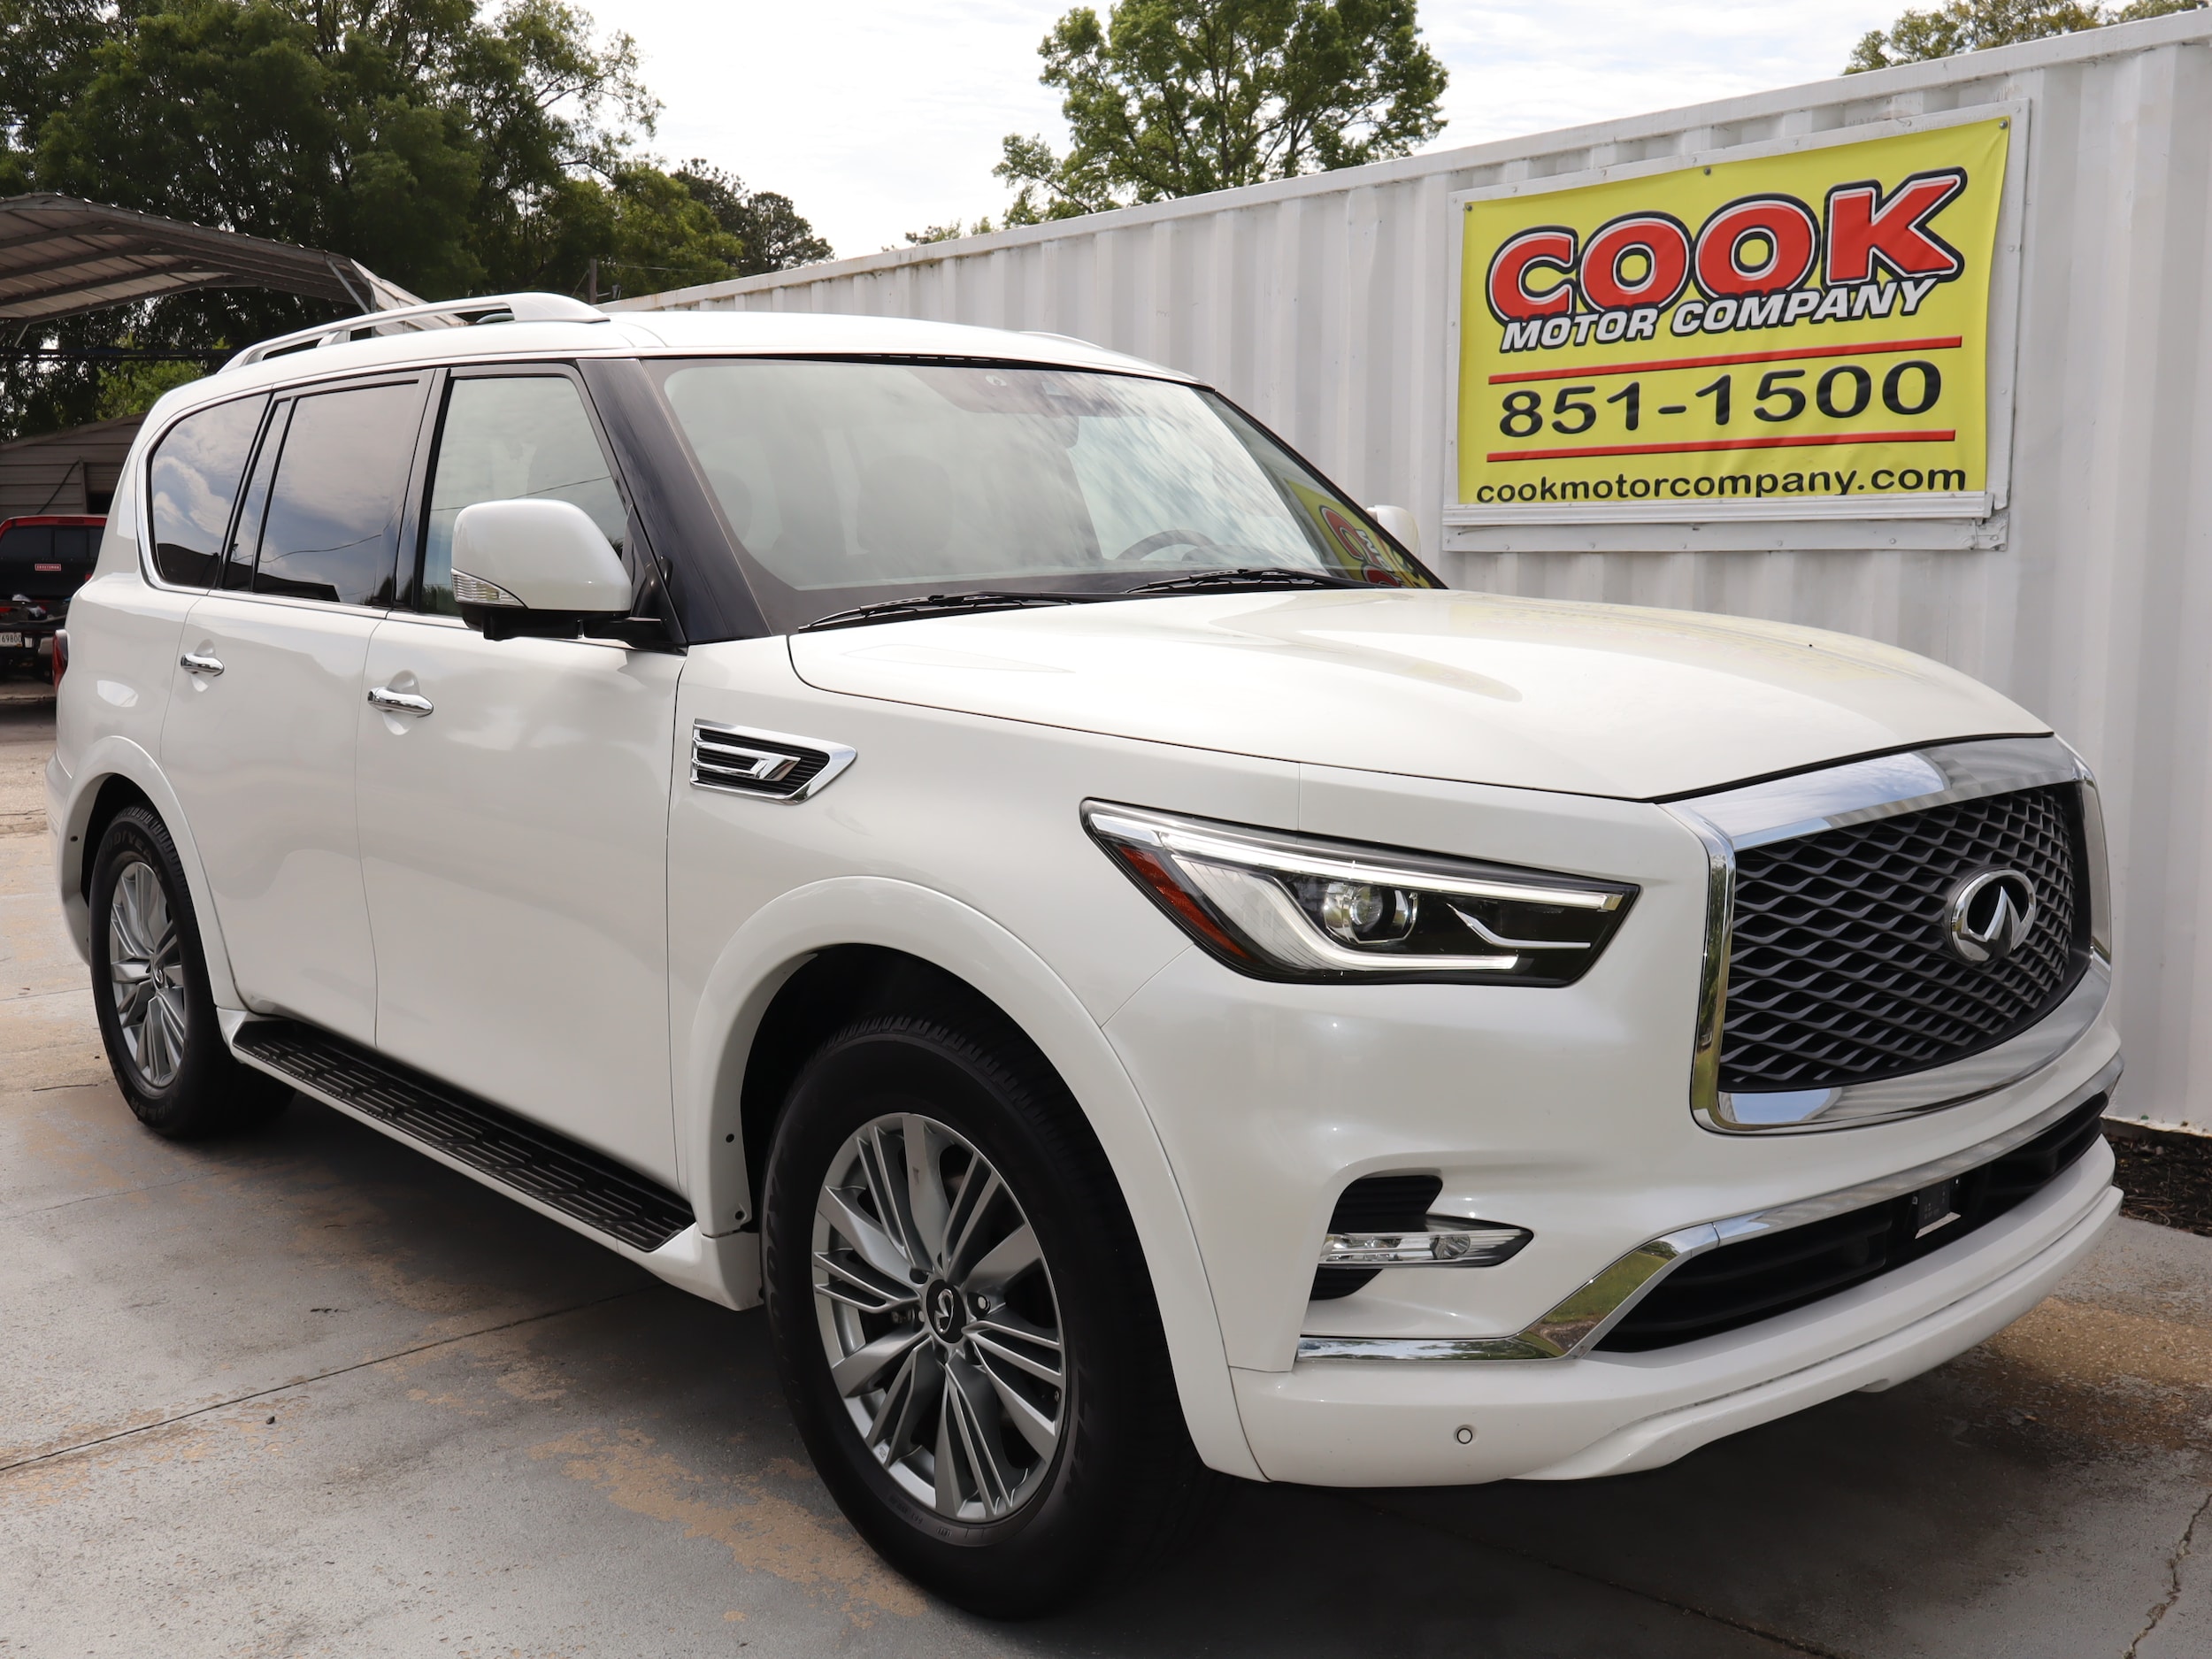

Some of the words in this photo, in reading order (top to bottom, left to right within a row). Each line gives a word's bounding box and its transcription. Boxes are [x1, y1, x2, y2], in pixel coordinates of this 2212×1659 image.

[1487, 166, 1966, 324] COOK
[1500, 307, 1659, 352] MOTOR
[1671, 277, 1939, 335] COMPANY
[1499, 360, 1941, 437] 851-1500
[1477, 467, 1967, 503] cookmotorcompany.com
